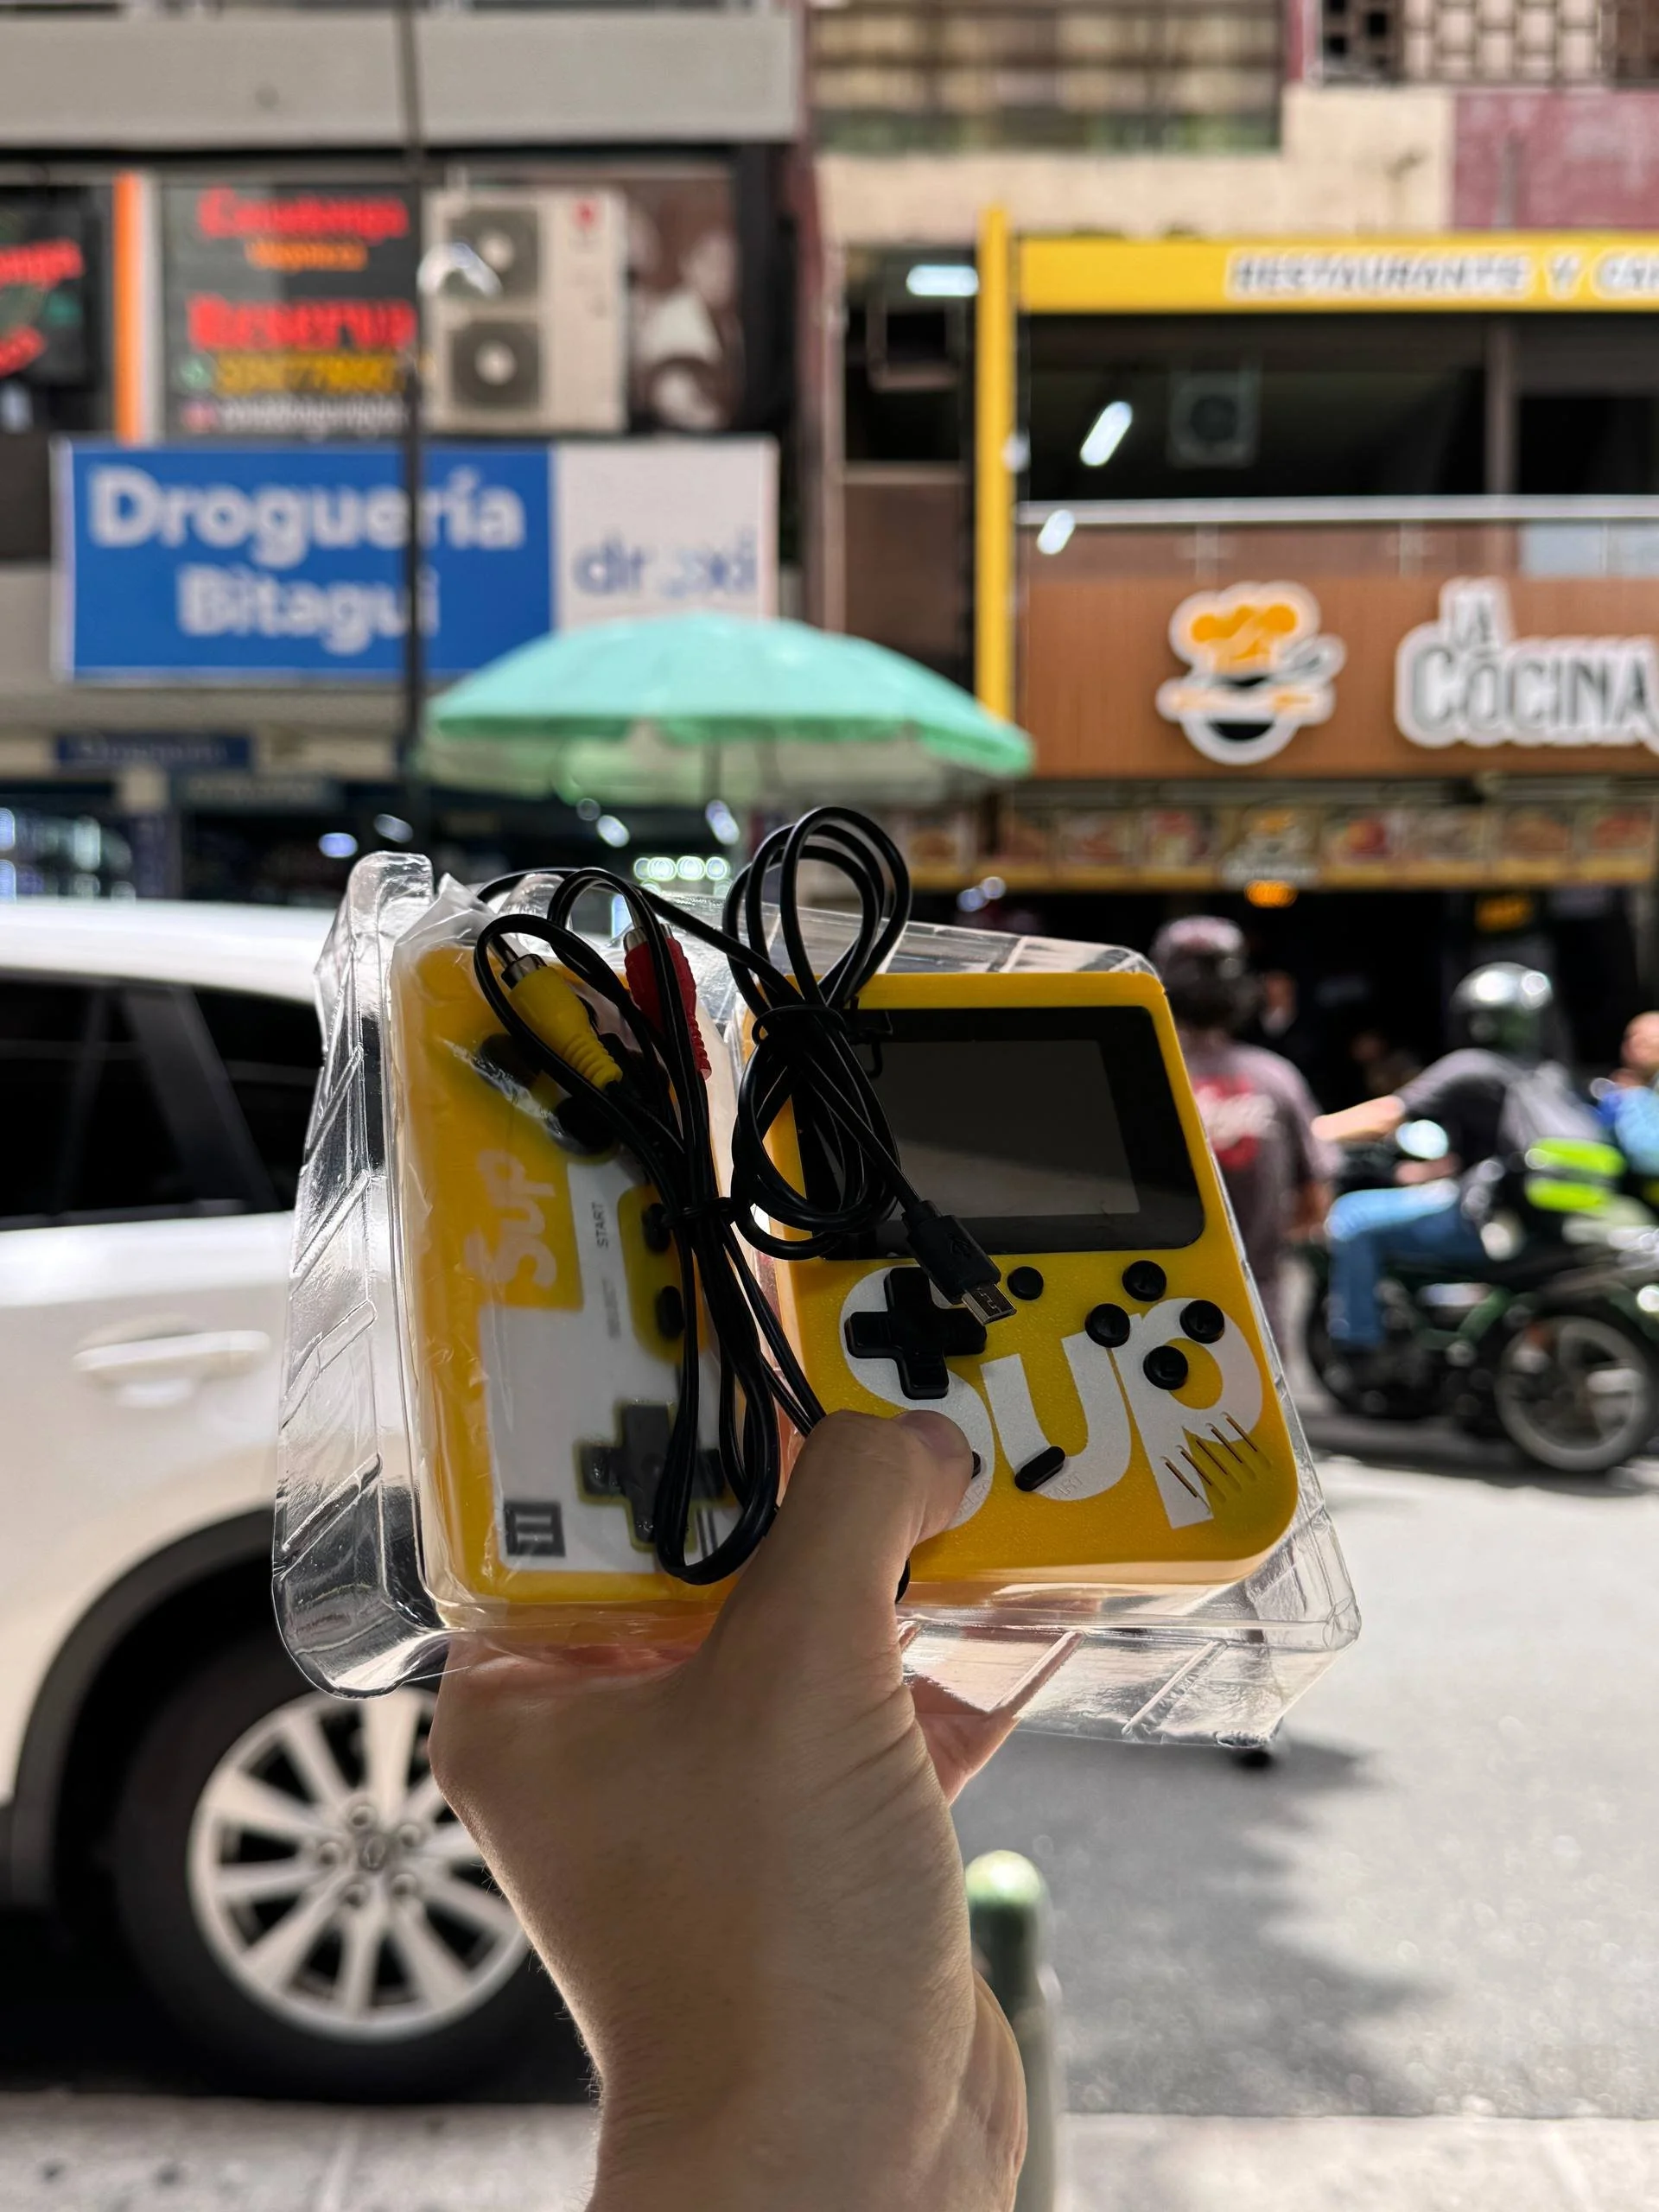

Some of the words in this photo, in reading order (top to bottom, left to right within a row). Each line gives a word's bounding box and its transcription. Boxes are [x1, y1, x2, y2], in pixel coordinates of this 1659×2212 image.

[1229, 251, 1529, 297] RESTAURANTE
[1547, 250, 1583, 298] Y
[88, 464, 525, 569] Droguería
[1403, 641, 1659, 741] COCINA
[591, 1201, 609, 1249] START
